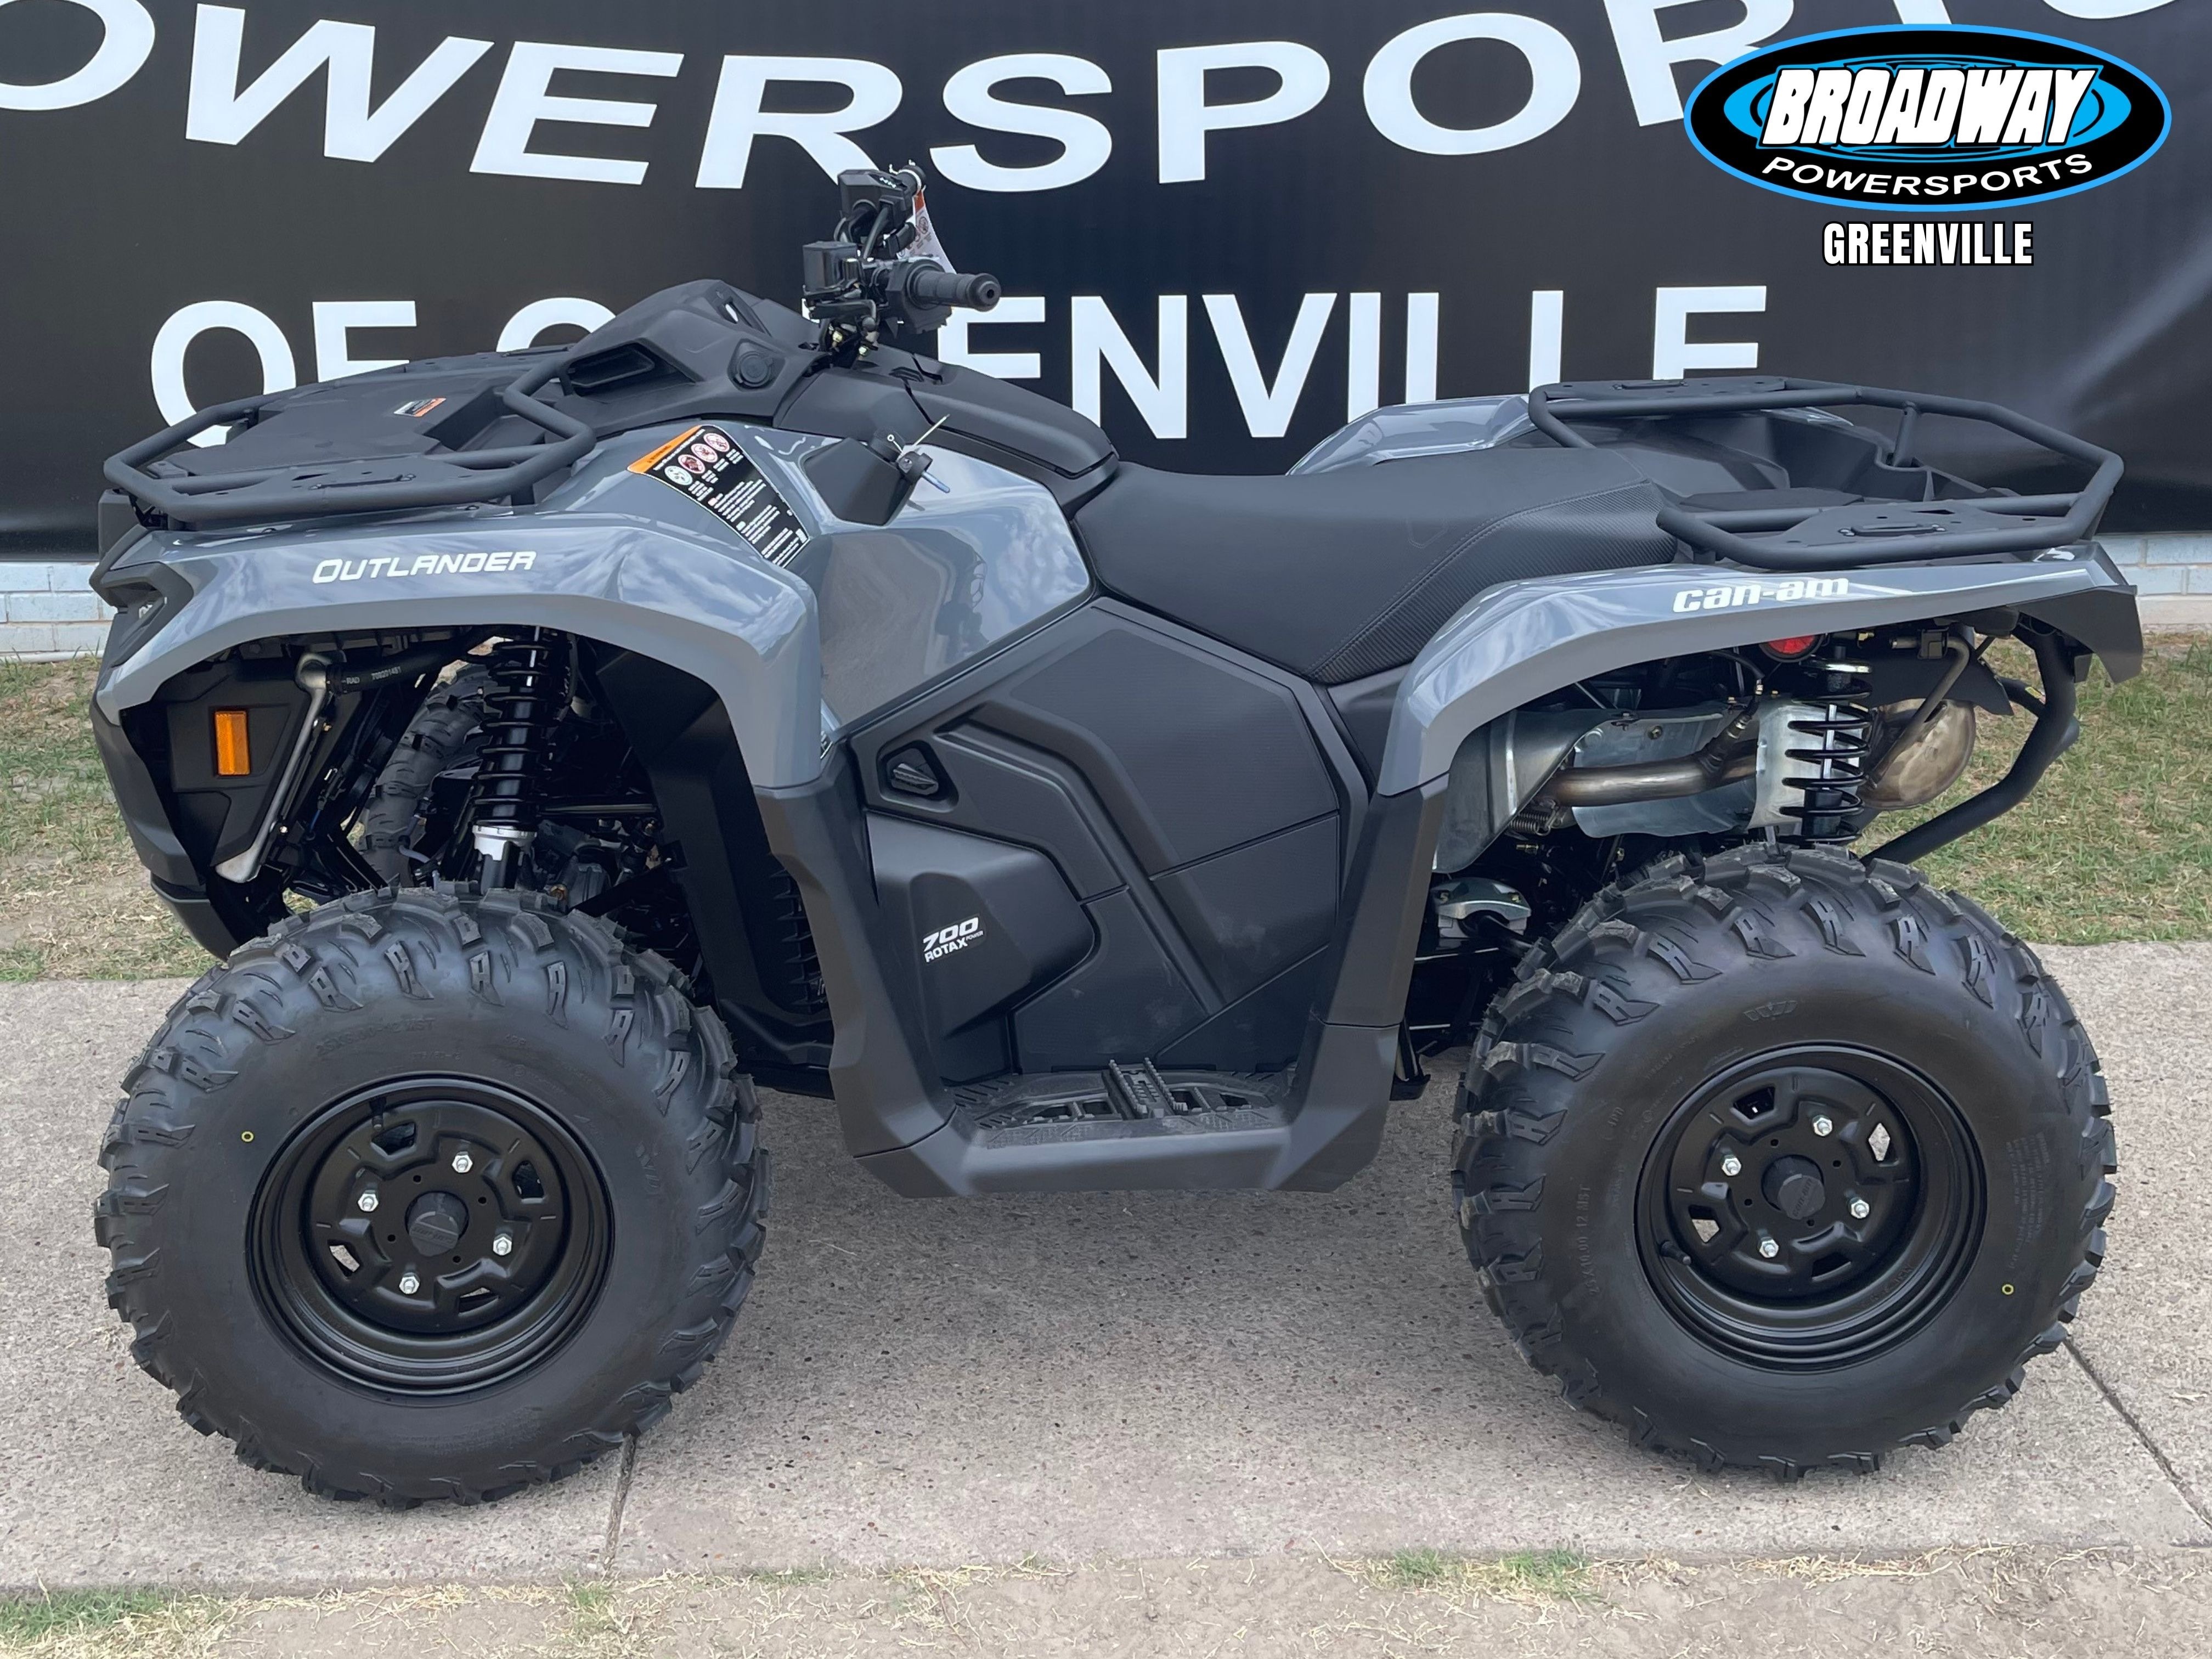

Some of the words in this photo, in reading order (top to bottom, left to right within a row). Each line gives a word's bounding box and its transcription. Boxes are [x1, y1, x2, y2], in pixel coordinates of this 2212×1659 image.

[0, 0, 2186, 192] OWERSPOR
[496, 285, 1768, 440] ENVILE
[312, 550, 537, 584] OUTLANDER
[1672, 578, 1849, 613] can-am
[923, 917, 979, 952] 700
[924, 936, 968, 963] ROTAX
[965, 930, 984, 941] POWER
